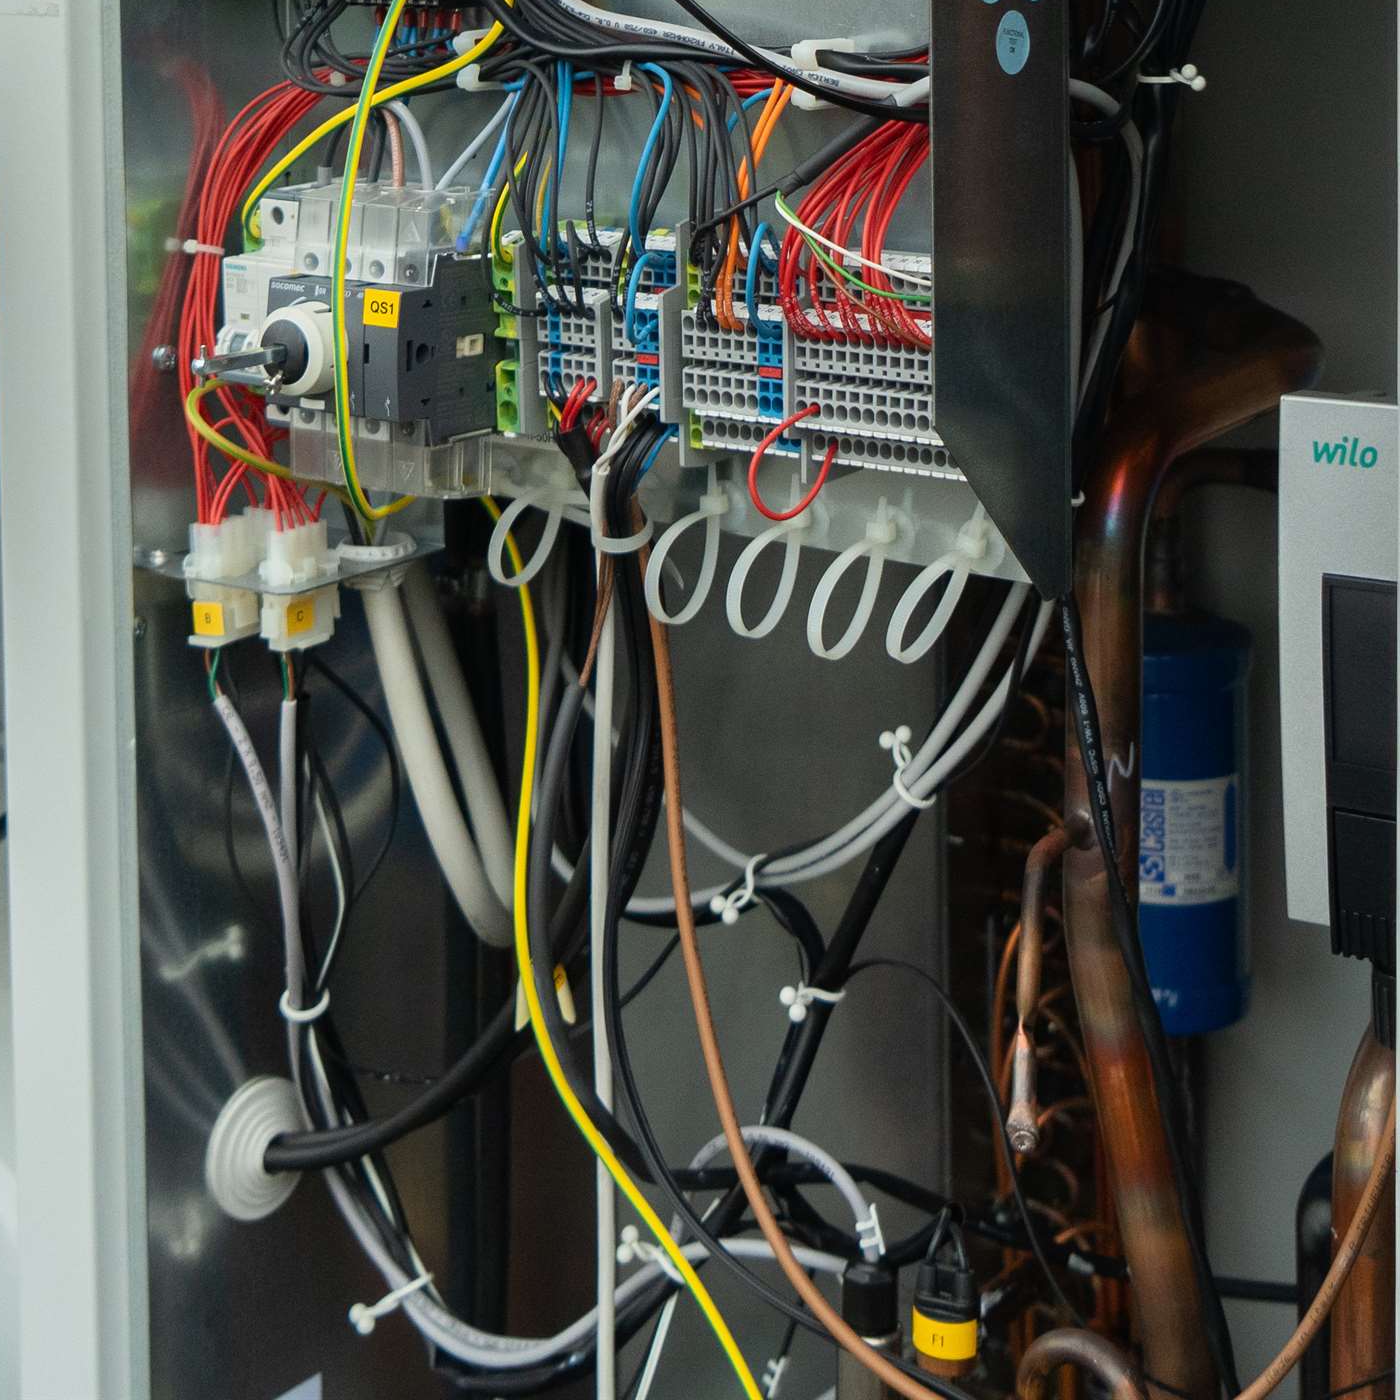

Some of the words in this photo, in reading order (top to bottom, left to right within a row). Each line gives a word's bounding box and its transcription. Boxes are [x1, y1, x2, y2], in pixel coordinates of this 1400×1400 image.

[271, 281, 306, 294] socomec
[370, 300, 395, 315] QS1
[1312, 436, 1378, 469] wilo
[931, 1334, 945, 1348] F1
